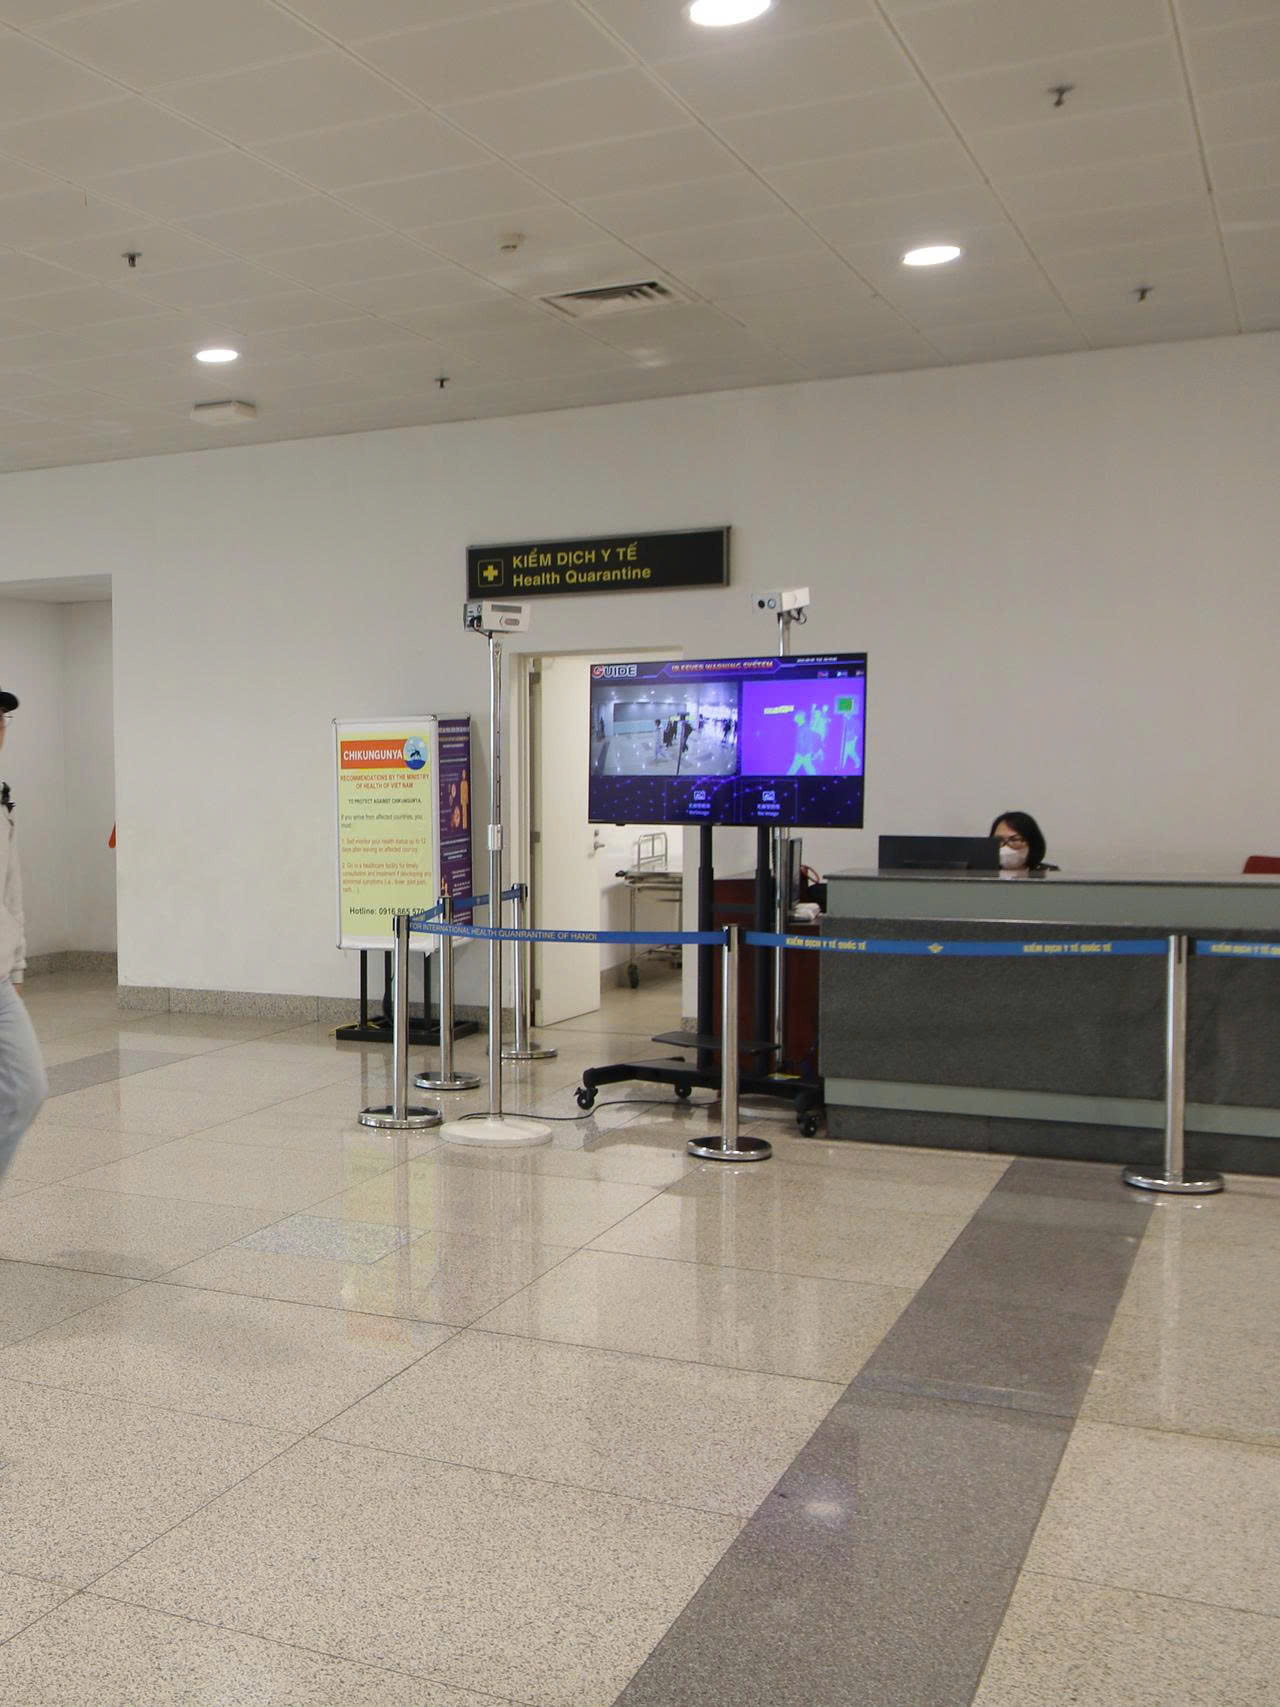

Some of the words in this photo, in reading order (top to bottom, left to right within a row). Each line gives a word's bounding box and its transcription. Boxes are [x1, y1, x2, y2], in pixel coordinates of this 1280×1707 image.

[557, 550, 596, 567] DỊCH
[601, 548, 611, 562] Y
[616, 541, 638, 561] TẾ
[512, 571, 560, 587] Health
[565, 566, 652, 584] Quarantine
[591, 663, 638, 679] GUIDE
[343, 749, 403, 761] CHIKUNGUNYA
[349, 905, 377, 915] Hotline:
[378, 907, 395, 915] 0916
[422, 924, 470, 935] INTERNATIONAL
[471, 927, 497, 937] HEALTH
[557, 932, 568, 940] OF
[570, 932, 597, 941] HANOI
